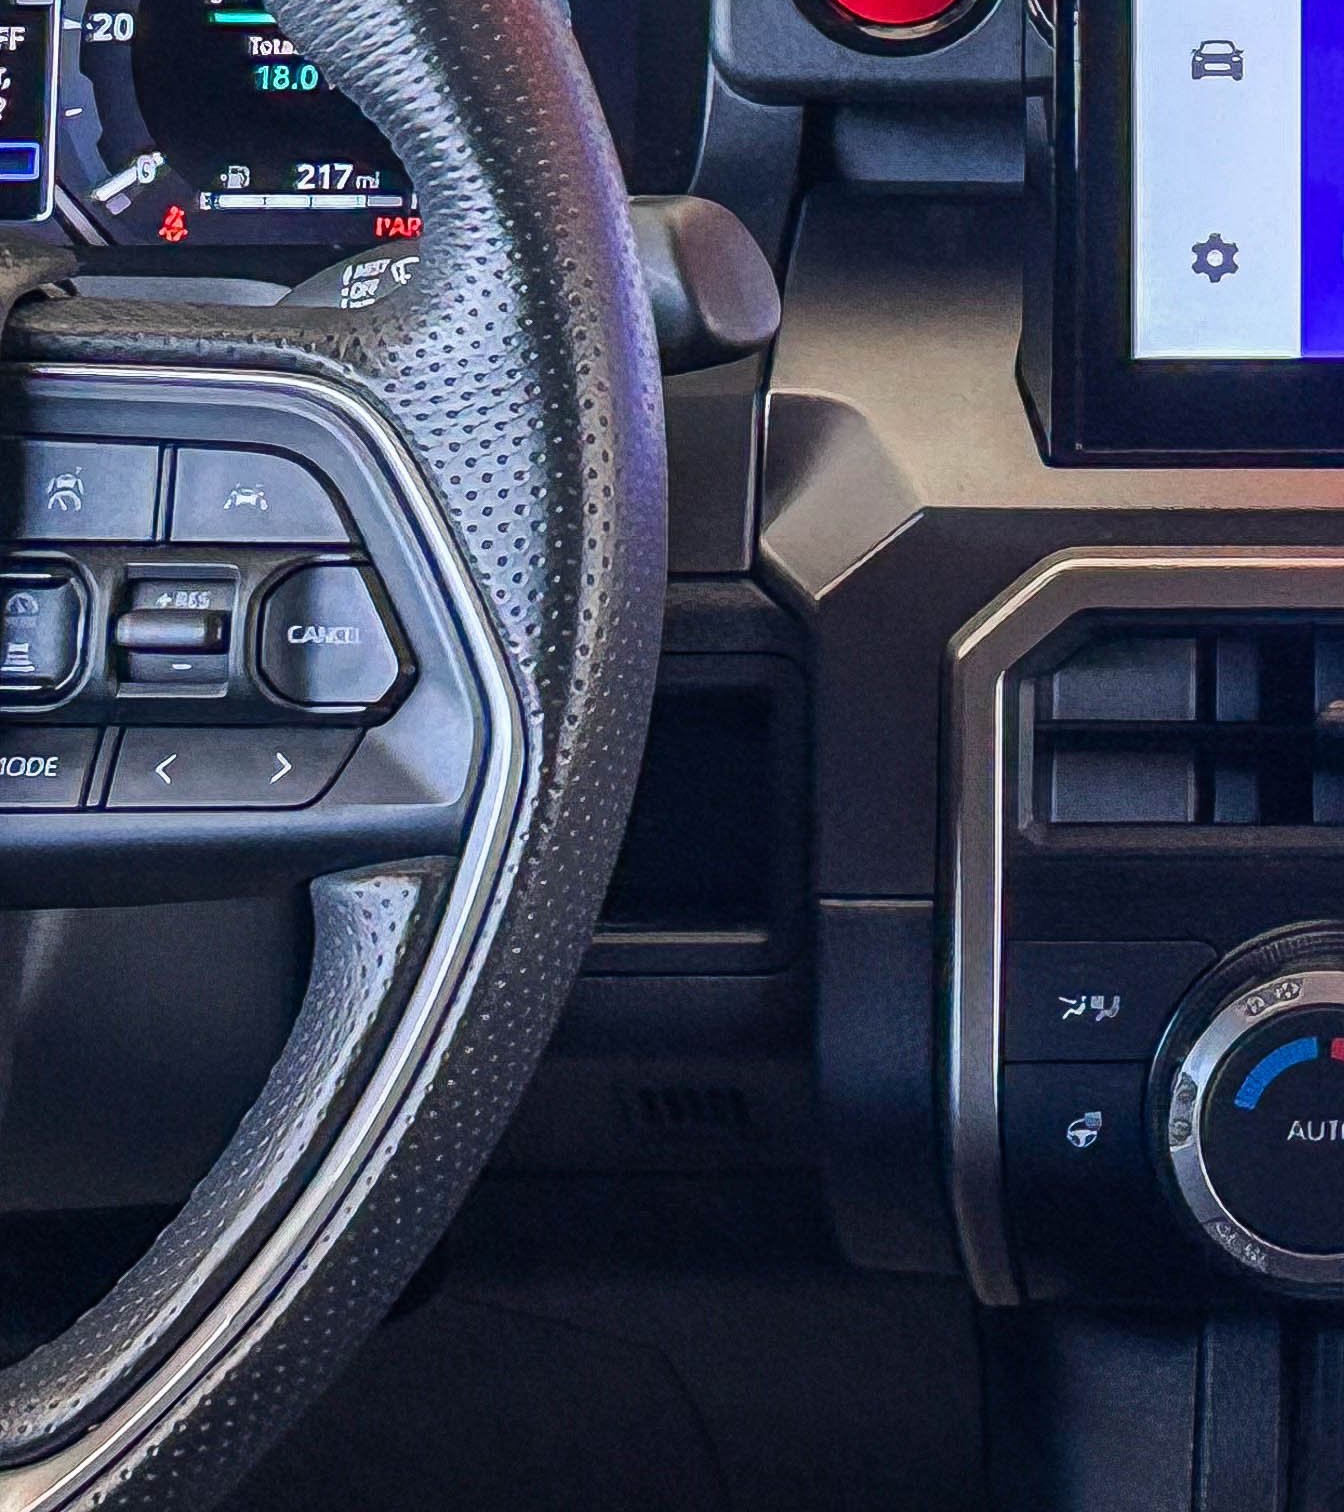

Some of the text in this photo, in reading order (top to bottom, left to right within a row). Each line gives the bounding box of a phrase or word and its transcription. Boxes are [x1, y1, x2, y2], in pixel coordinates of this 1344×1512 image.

[92, 12, 134, 41] 20
[249, 36, 299, 56] Tota
[257, 65, 319, 90] 18.0
[296, 163, 381, 190] 217 mi
[375, 216, 422, 237] PAR
